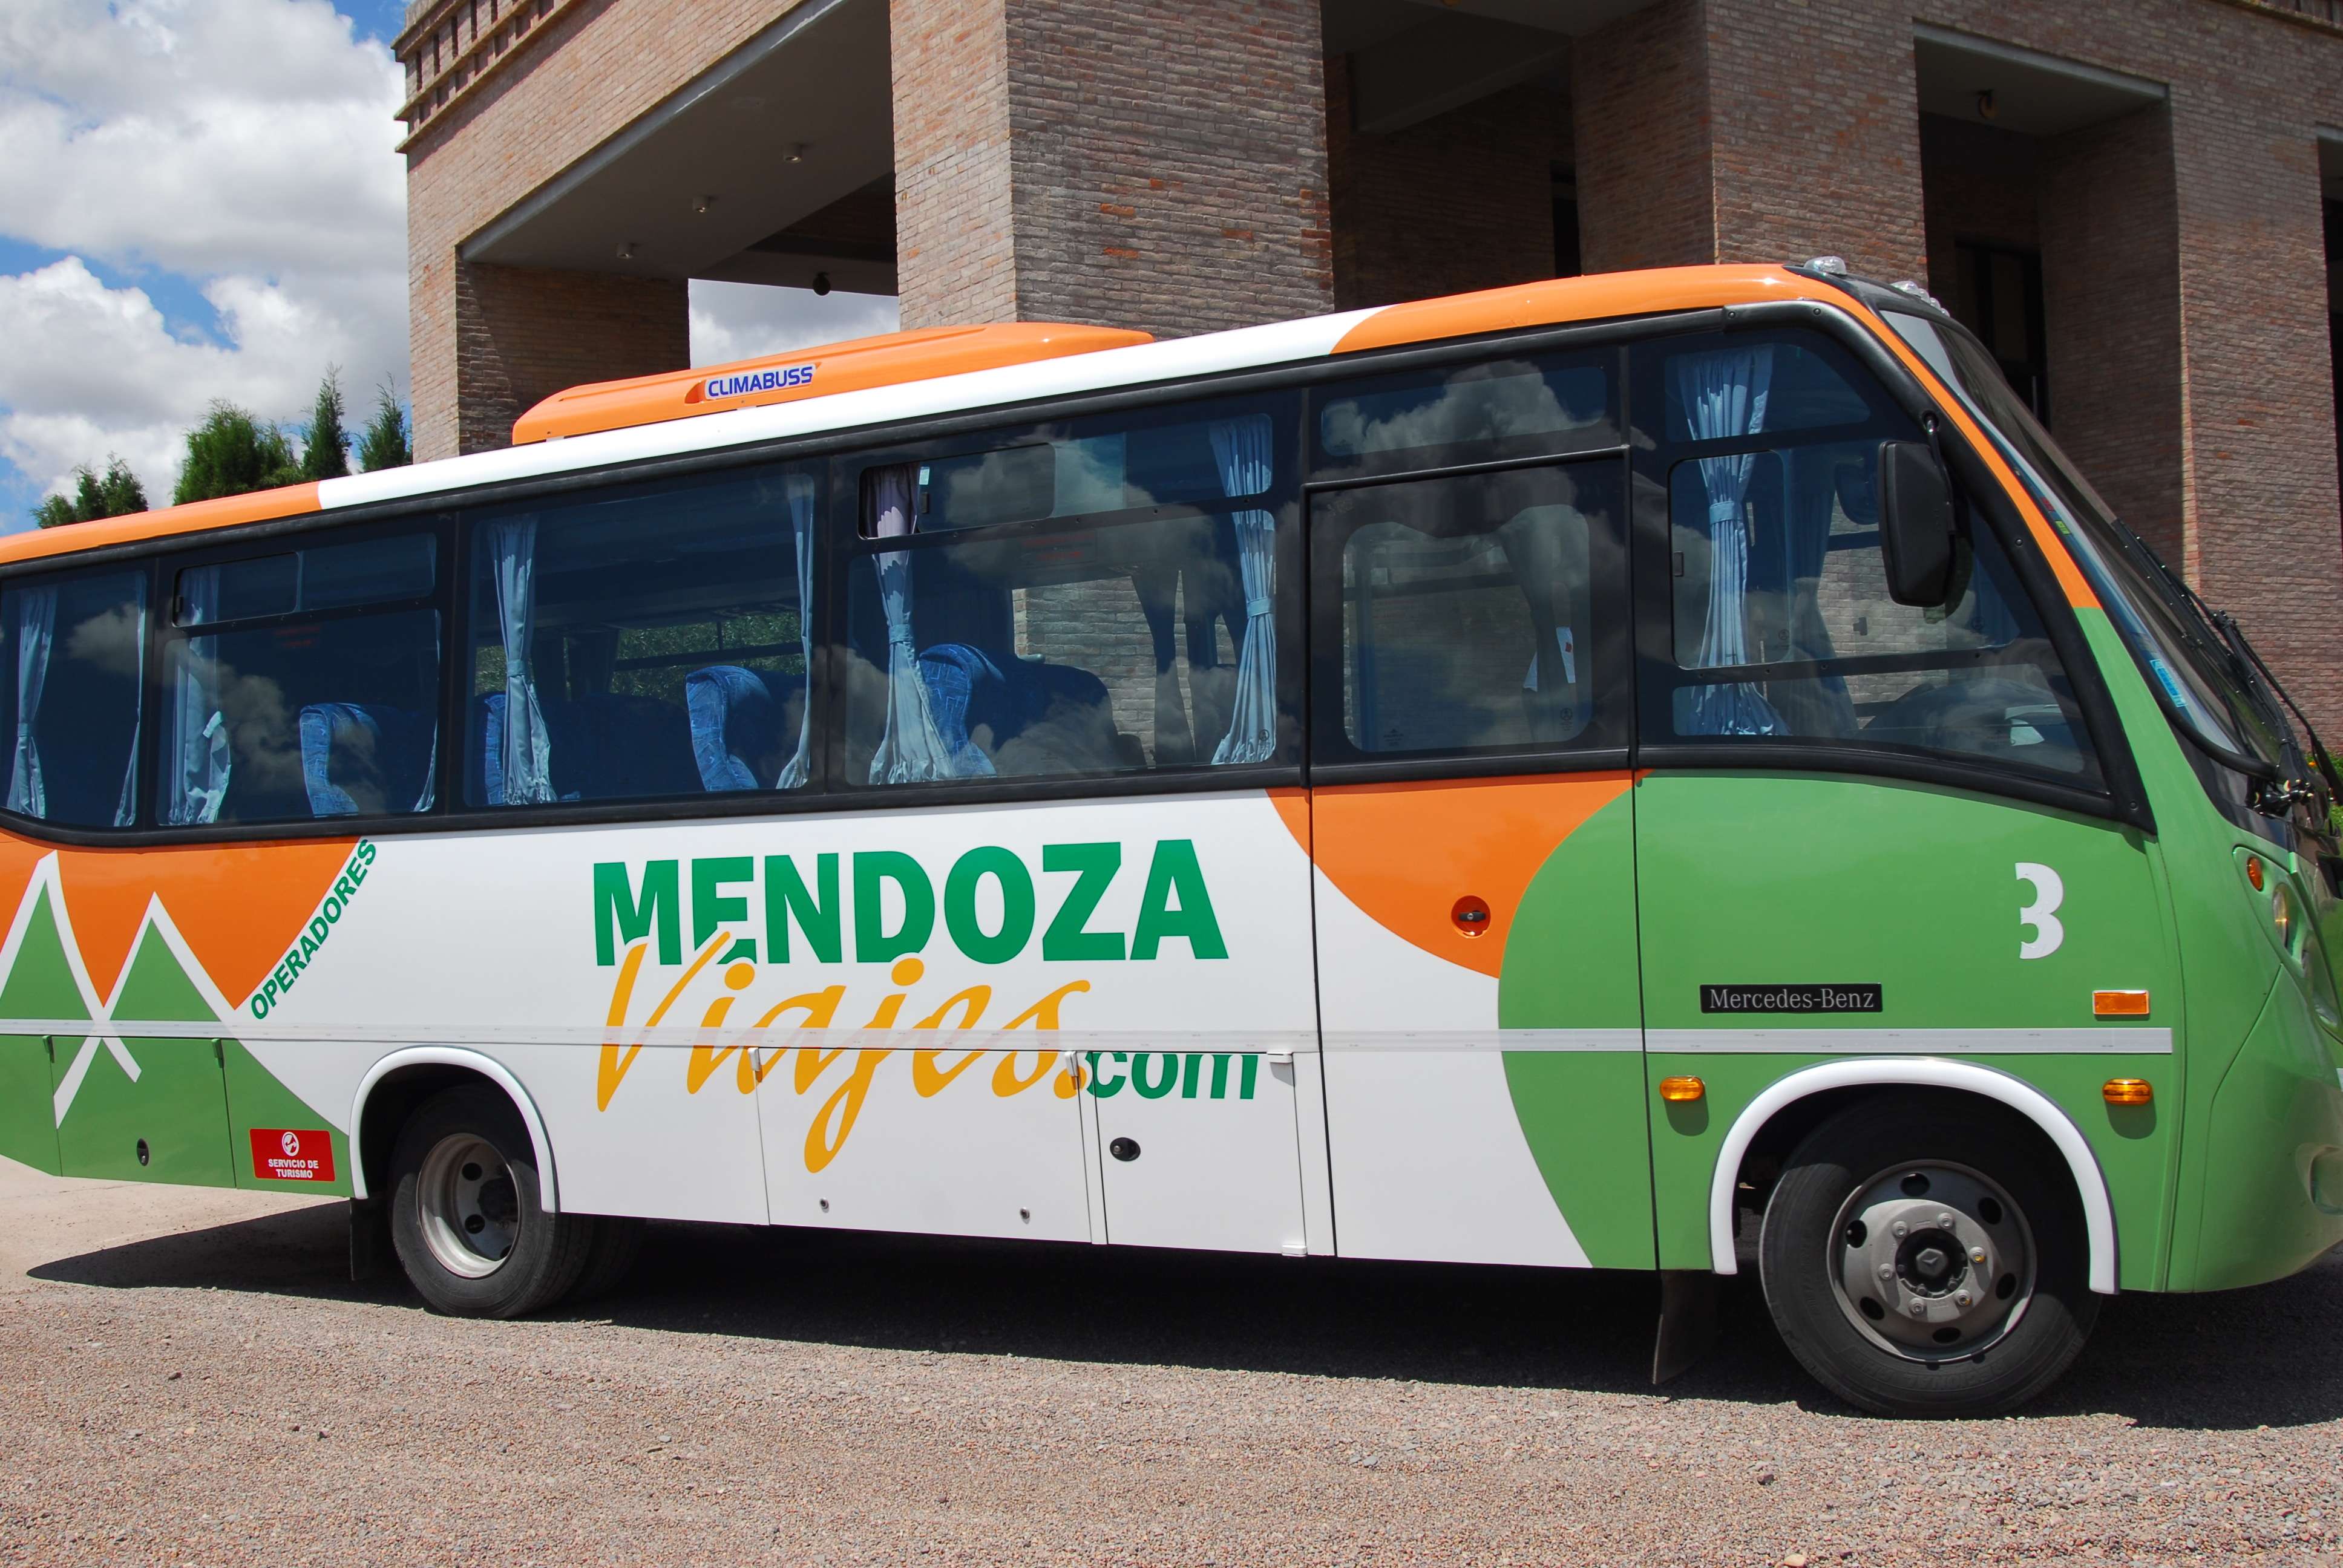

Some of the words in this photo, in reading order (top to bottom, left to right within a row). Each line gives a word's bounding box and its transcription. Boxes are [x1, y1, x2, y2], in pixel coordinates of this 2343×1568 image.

[708, 366, 813, 397] CLIMABUSS
[592, 839, 1230, 966] MENDOZA
[2015, 862, 2064, 959] 3
[250, 838, 377, 1020] OPERADORES
[1709, 988, 1874, 1008] Mercedes-Benz
[268, 1158, 306, 1169] SERVICIO
[307, 1160, 319, 1169] DE
[276, 1169, 313, 1178] TURISMO
